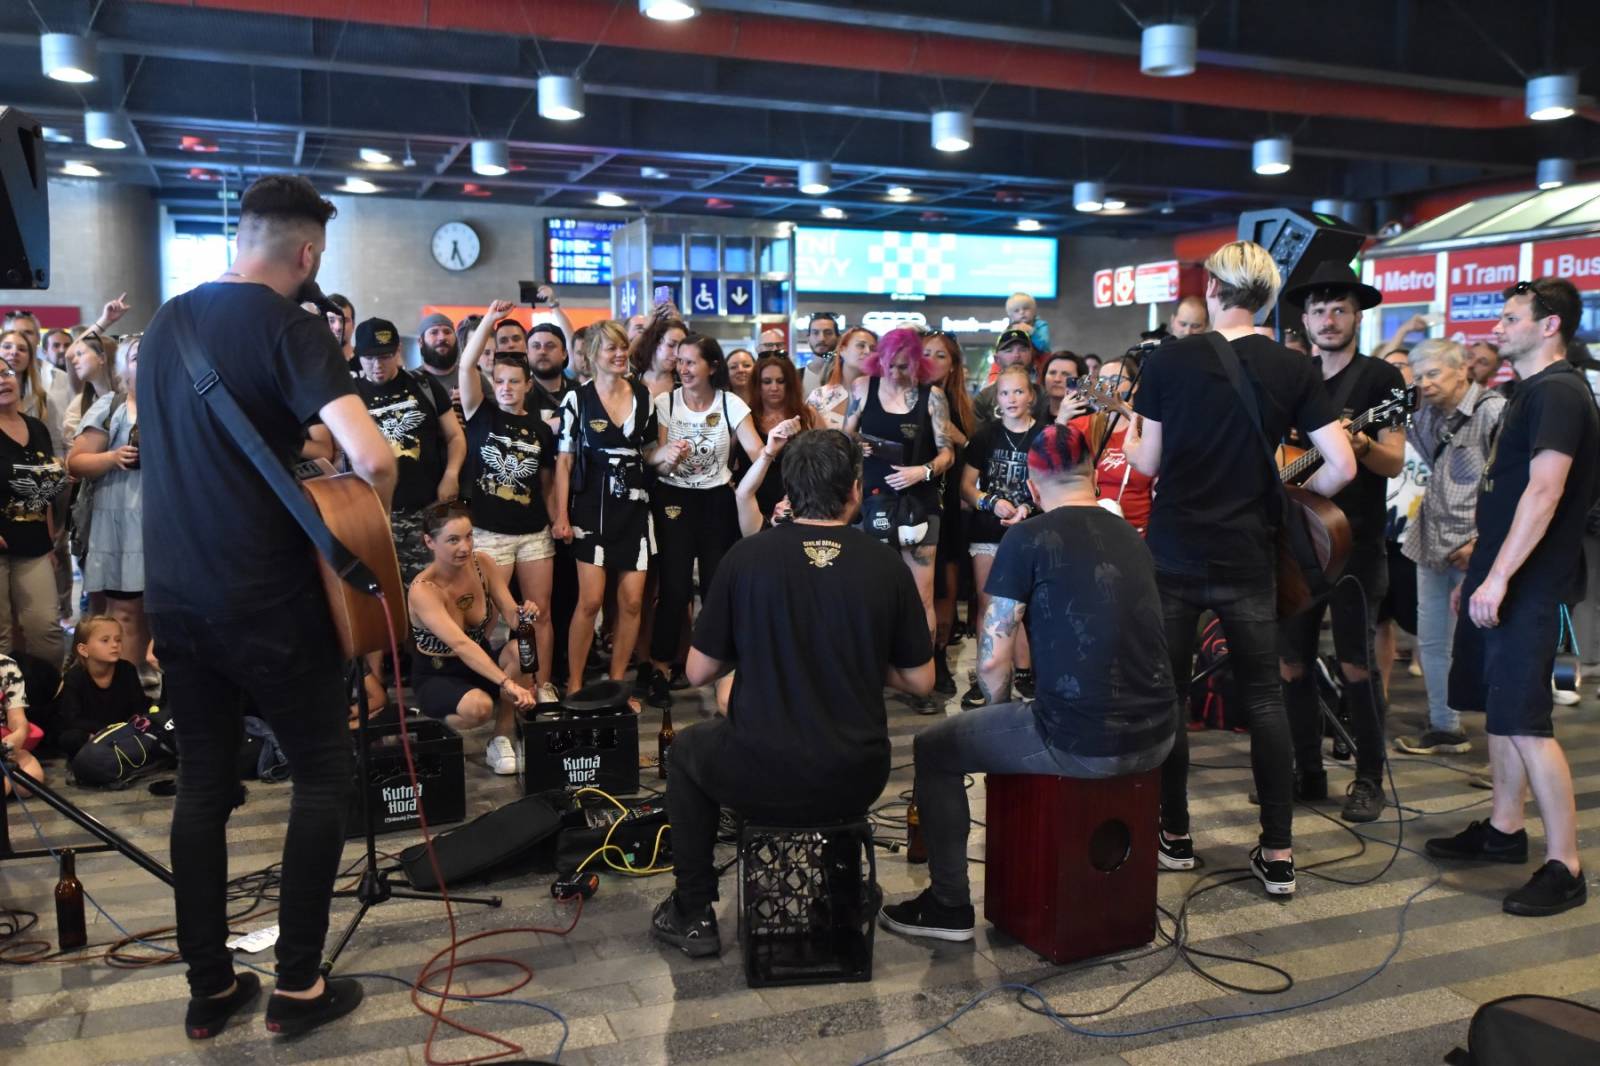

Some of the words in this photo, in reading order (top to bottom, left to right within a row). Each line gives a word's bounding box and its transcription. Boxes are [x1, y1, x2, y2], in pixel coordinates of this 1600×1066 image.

[1464, 263, 1516, 286] Tram
[1558, 254, 1600, 278] Bus
[1097, 276, 1112, 302] C
[1384, 270, 1436, 292] Metro
